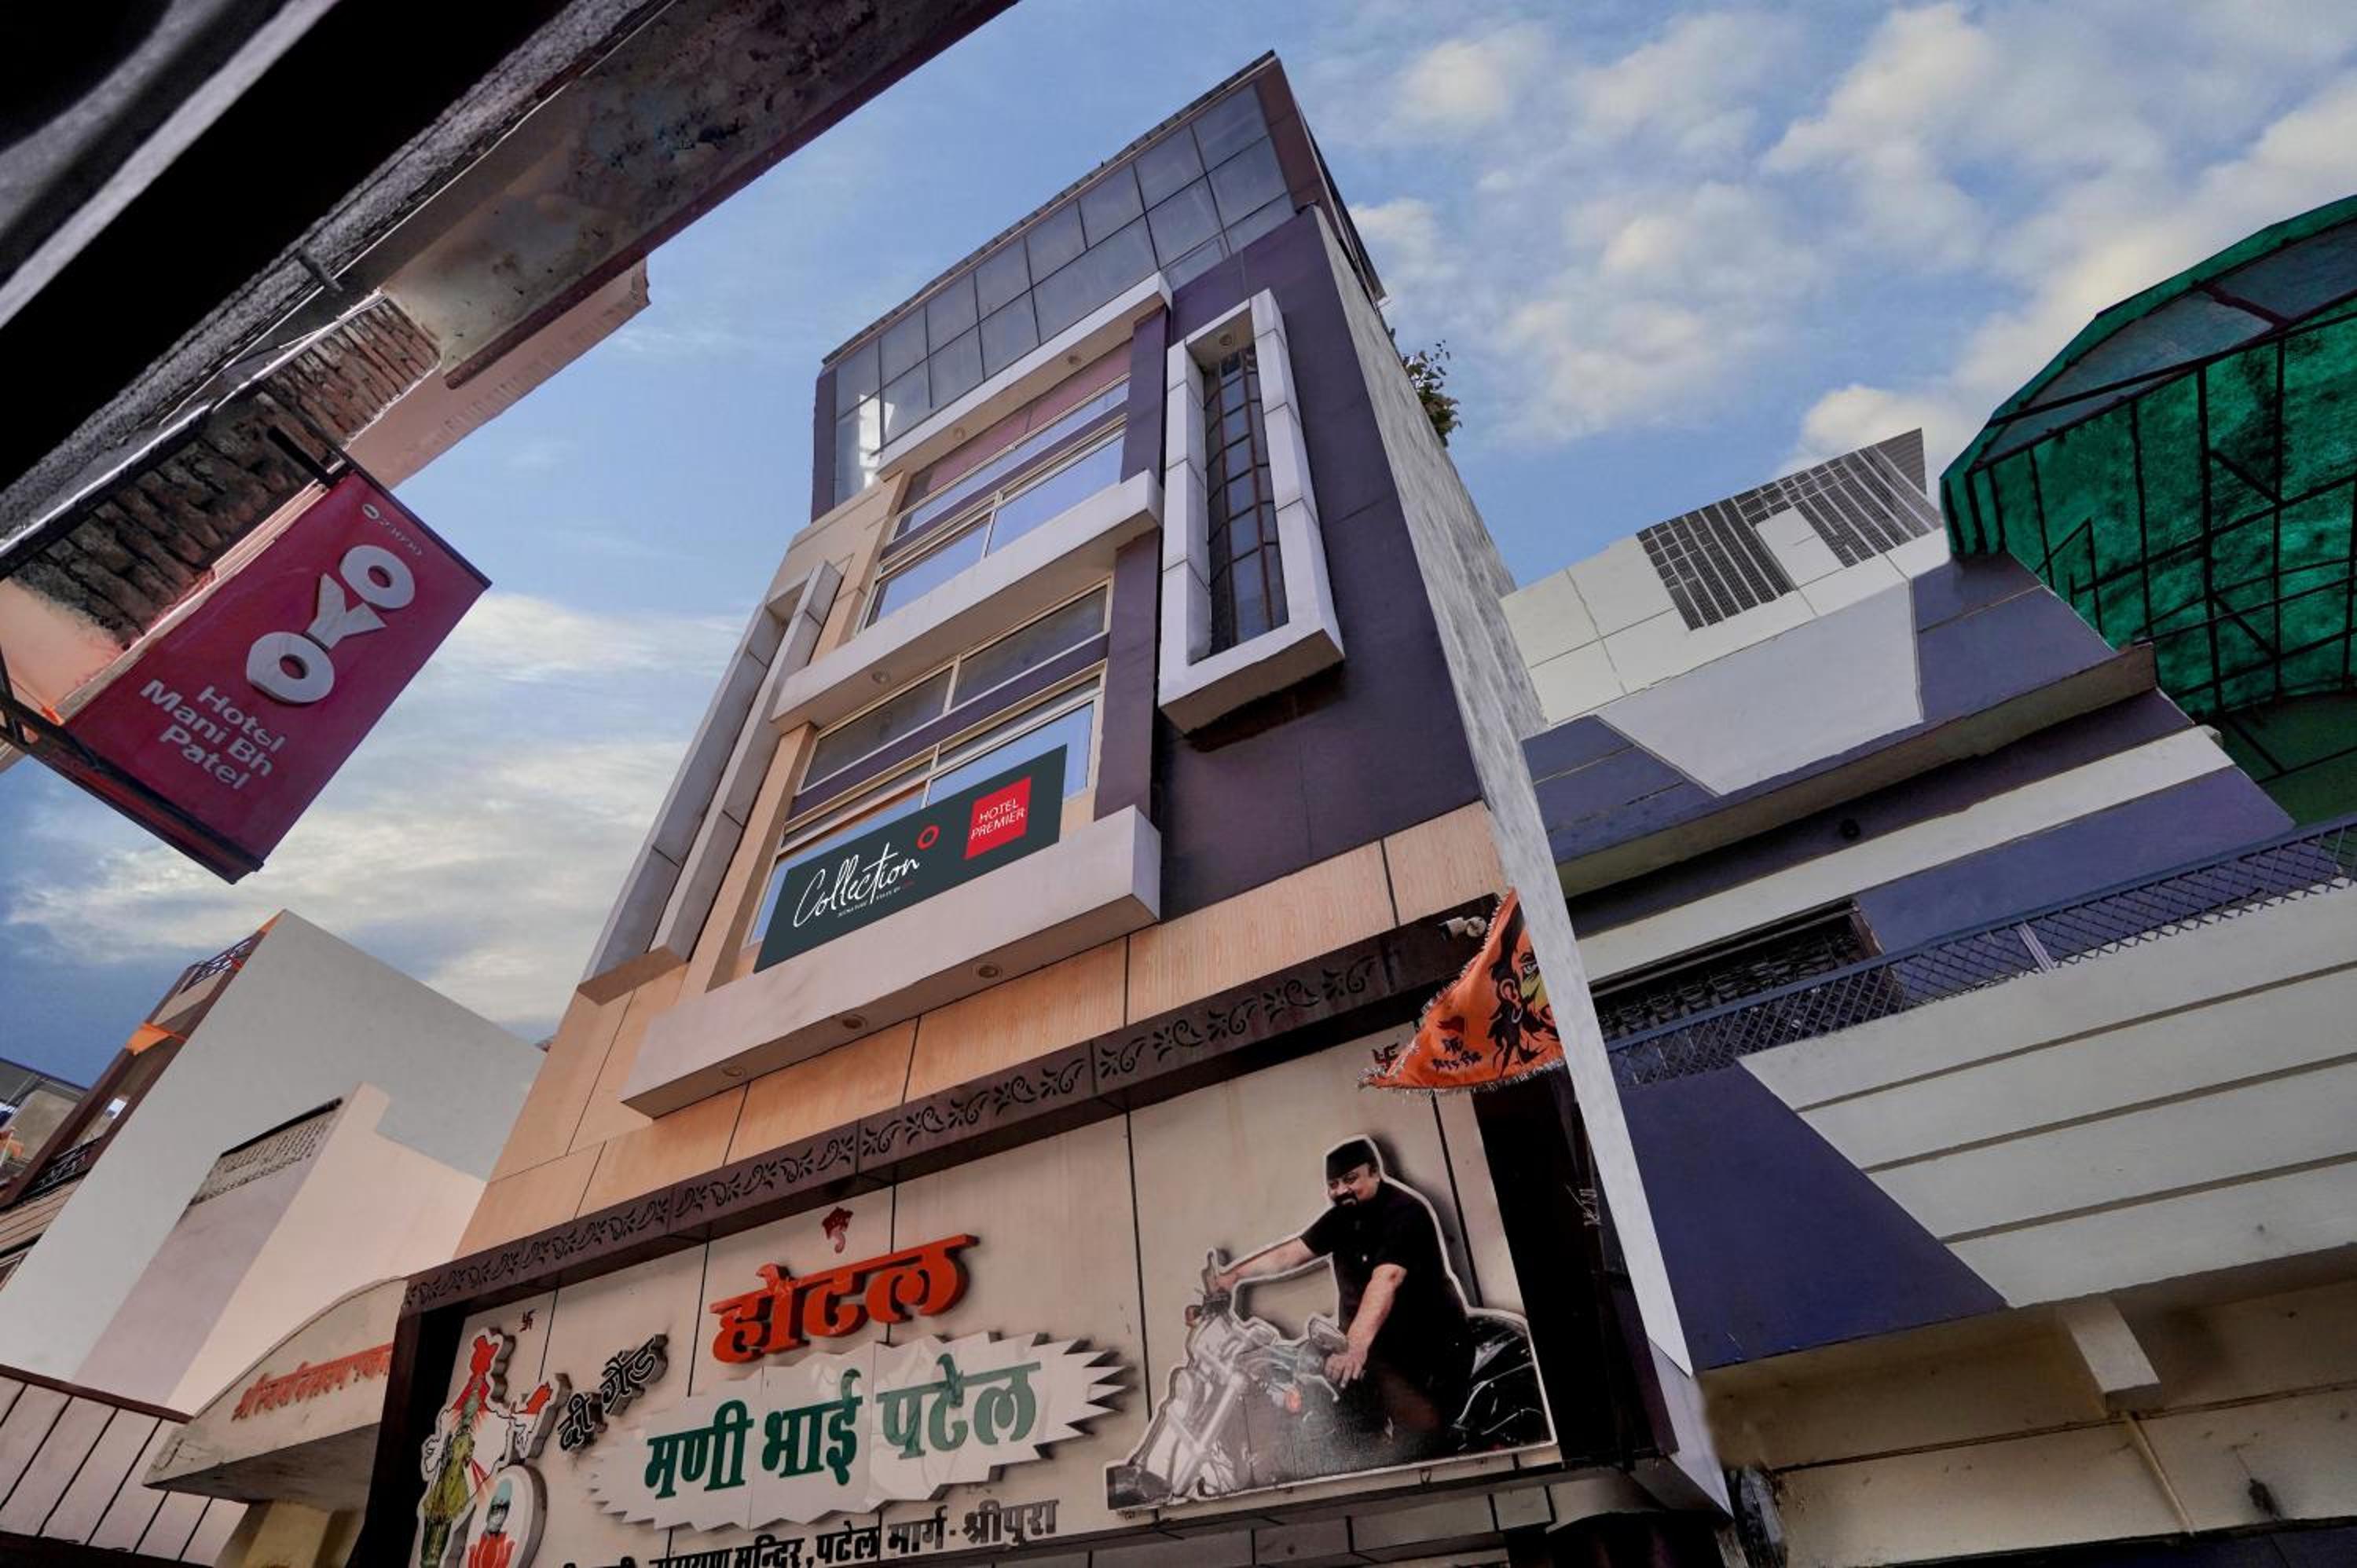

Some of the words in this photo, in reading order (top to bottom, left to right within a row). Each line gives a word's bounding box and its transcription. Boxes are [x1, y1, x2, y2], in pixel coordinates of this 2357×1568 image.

[246, 544, 416, 705] OYO
[140, 679, 230, 745] Mani
[228, 738, 273, 776] Bh
[159, 724, 251, 789] Patel
[198, 686, 286, 753] Hotel
[970, 807, 1025, 840] PREMIER
[978, 797, 1019, 824] HOTEL
[793, 841, 920, 928] Collection
[709, 1234, 976, 1364] होटल
[644, 1399, 754, 1500] मणी
[761, 1368, 863, 1486] भाई
[875, 1353, 1042, 1460] पटेल
[816, 1519, 881, 1564] पटेल
